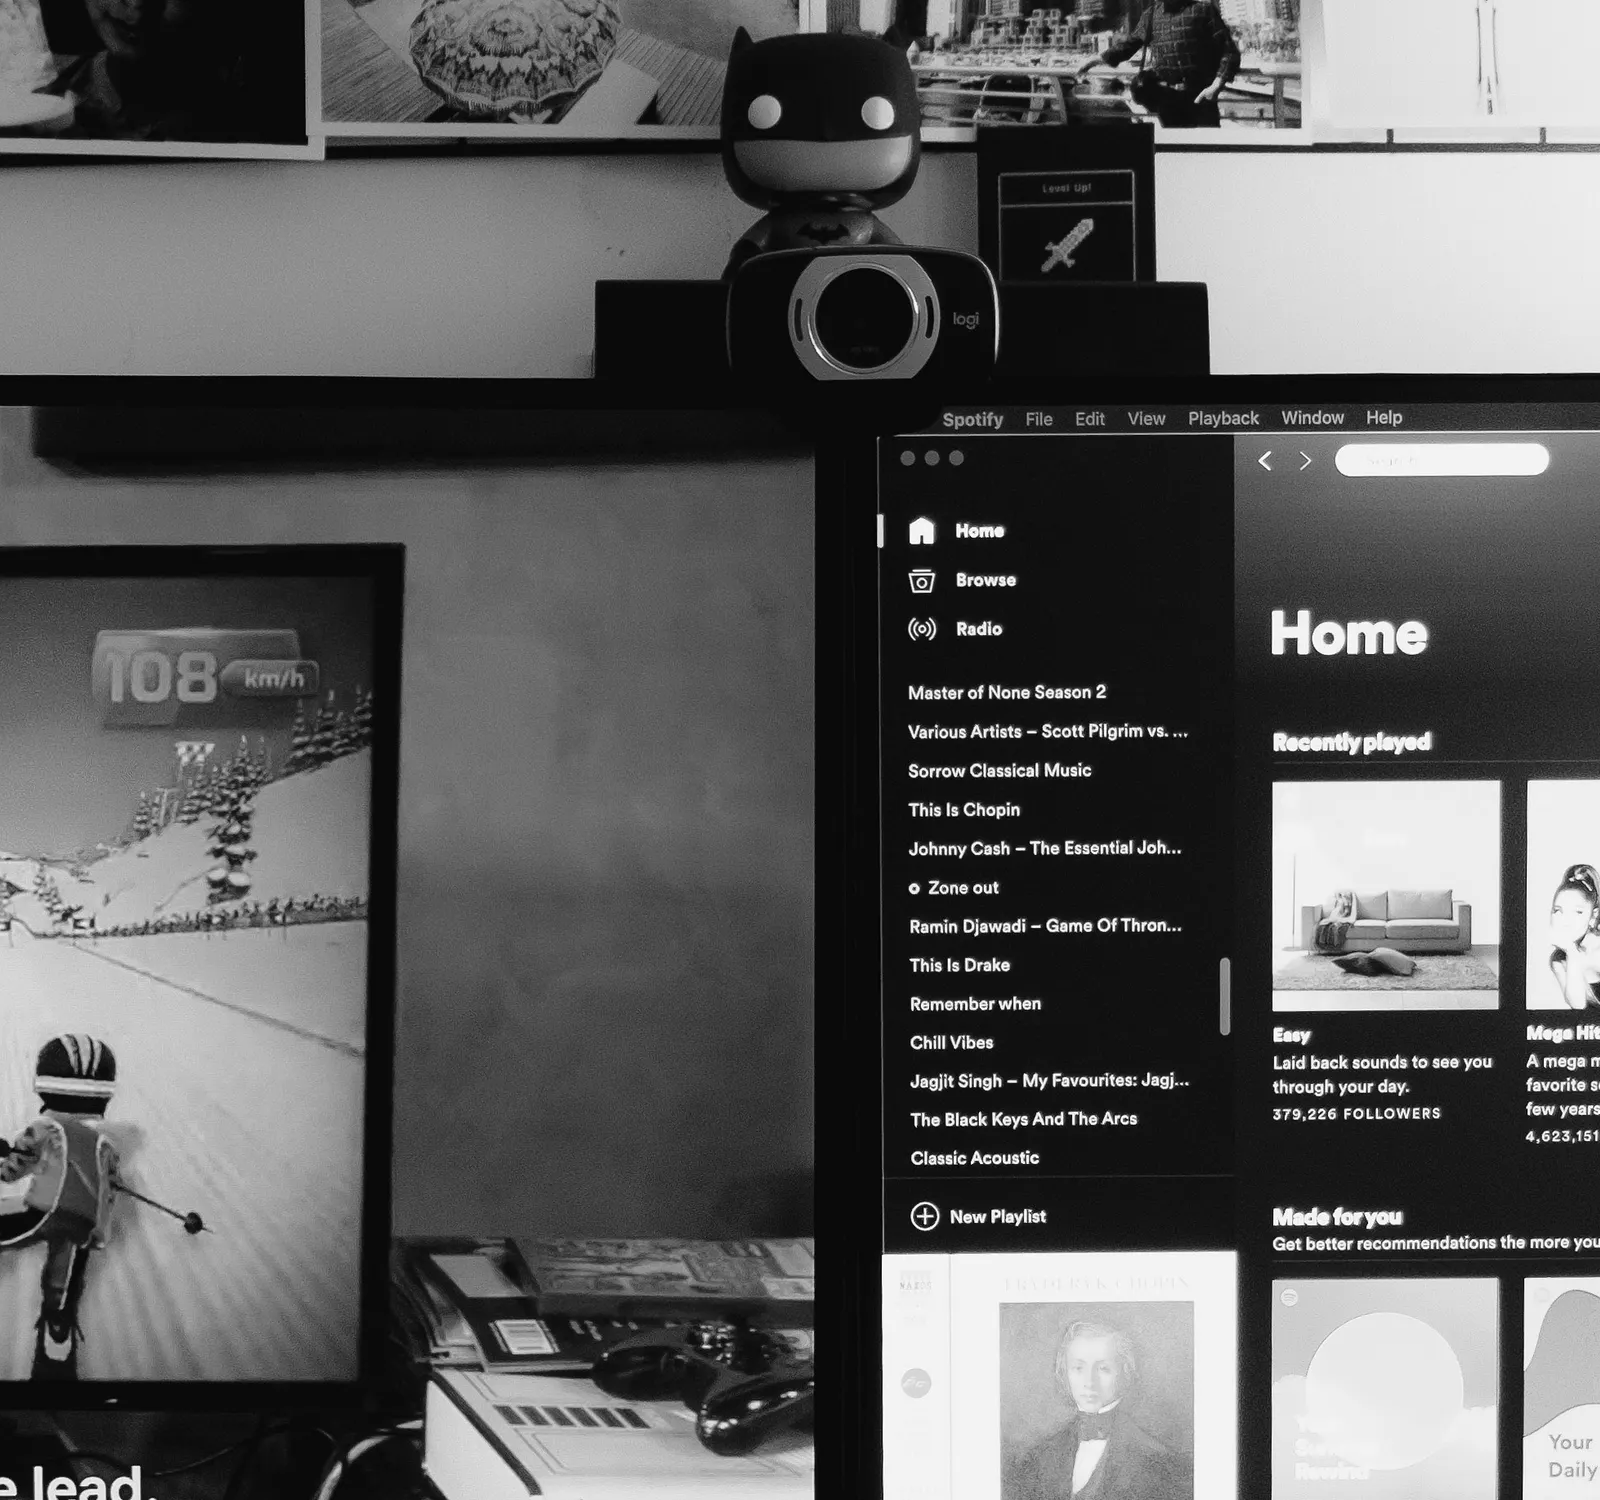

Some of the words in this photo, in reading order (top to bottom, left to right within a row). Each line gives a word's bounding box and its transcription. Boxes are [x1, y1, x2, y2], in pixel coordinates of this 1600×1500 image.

[953, 312, 979, 330] logi
[944, 412, 1003, 429] Spotify
[1027, 412, 1052, 426] File
[1076, 412, 1105, 426] Edit
[1128, 411, 1166, 425] View
[1189, 411, 1259, 428] Playback
[1282, 410, 1344, 425] Window
[1367, 410, 1403, 427] Help
[956, 523, 1005, 538] Home
[957, 572, 1016, 587] Browse
[957, 621, 1002, 636] Radio
[1272, 610, 1428, 655] Home
[106, 652, 217, 702] 108
[245, 668, 304, 688] km/h
[909, 686, 964, 700] Master
[968, 685, 984, 699] of
[989, 685, 1030, 699] None
[1035, 685, 1091, 699] Season
[1096, 684, 1106, 698] 2
[1273, 732, 1362, 755] Recently
[1363, 731, 1432, 755] played
[909, 764, 965, 778] Sorrow
[970, 763, 1039, 777] Classical
[1045, 763, 1091, 777] Music
[908, 803, 941, 817] This
[947, 803, 959, 817] Is
[963, 802, 1020, 819] Chopin
[929, 880, 968, 894] Zone
[973, 882, 999, 894] out
[910, 958, 942, 972] This
[947, 958, 960, 972] Is
[965, 958, 1010, 972] Drake
[911, 997, 995, 1011] Remember
[999, 996, 1041, 1010] when
[910, 1035, 946, 1050] Chill
[950, 1035, 993, 1049] Vibes
[910, 1113, 940, 1127] The
[945, 1112, 987, 1126] Black
[992, 1112, 1028, 1129] Keys
[1033, 1112, 1064, 1125] And
[1068, 1111, 1098, 1125] The
[1102, 1111, 1137, 1125] Arcs
[1273, 1108, 1336, 1121] 379,226
[1344, 1107, 1440, 1119] FOLLOWERS
[951, 1210, 986, 1224] New
[991, 1209, 1046, 1226] Playlist
[1273, 1207, 1331, 1226] Made
[1333, 1206, 1362, 1226] for
[1364, 1210, 1403, 1230] you
[1549, 1434, 1593, 1450] Your
[1549, 1462, 1597, 1481] Daily
